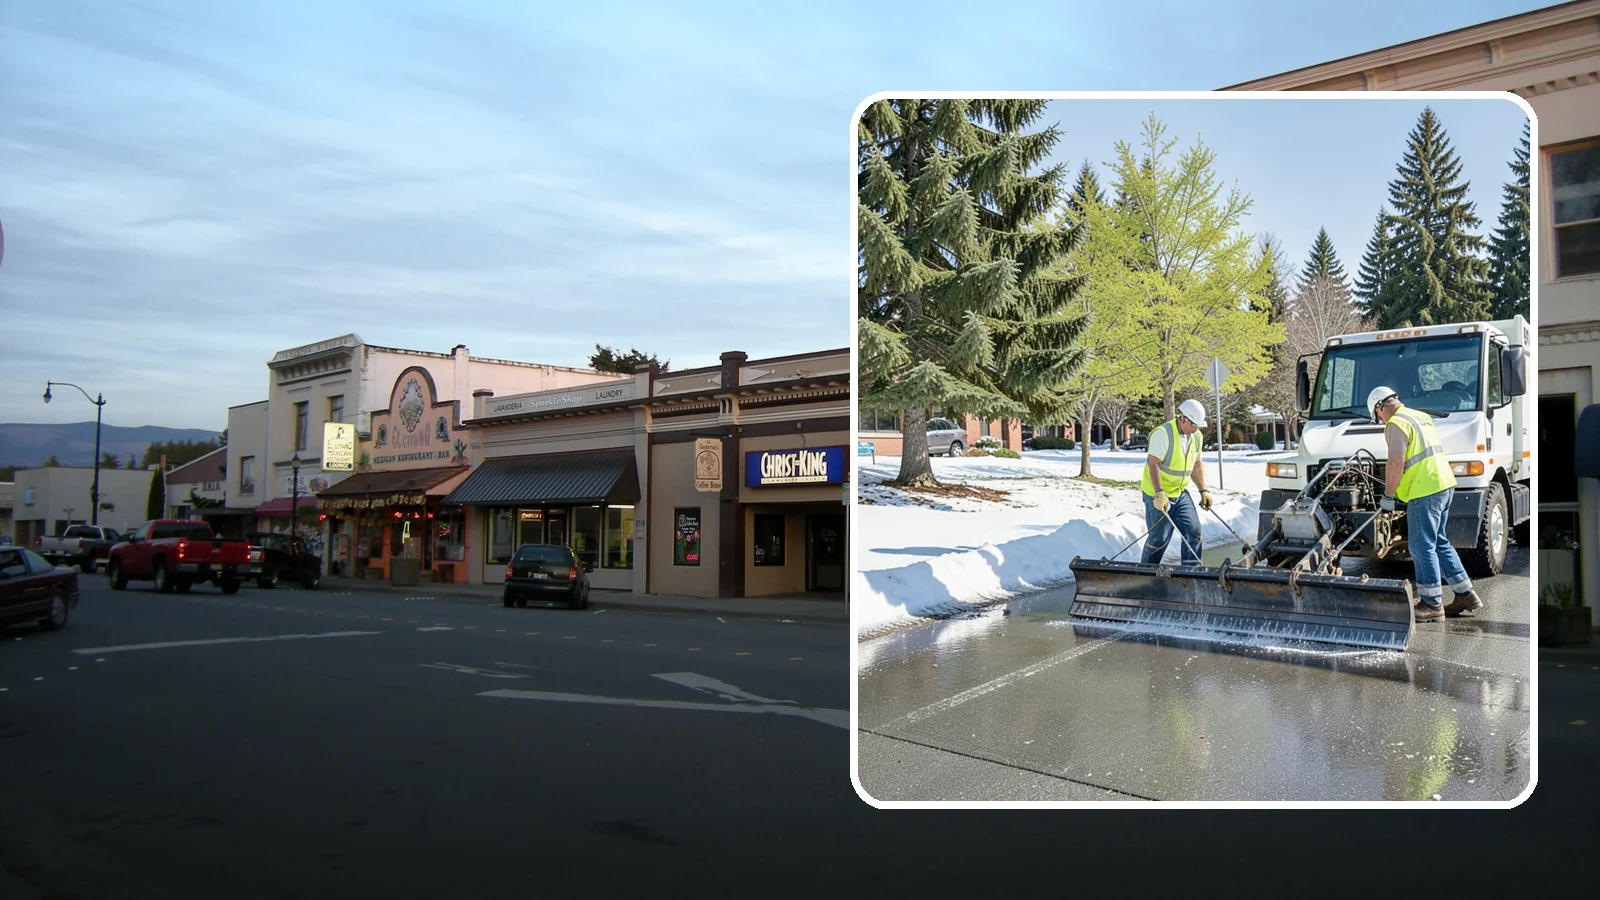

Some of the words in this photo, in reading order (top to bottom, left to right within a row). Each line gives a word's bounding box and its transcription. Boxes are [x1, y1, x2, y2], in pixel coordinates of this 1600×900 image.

[530, 397, 561, 409] Sparkle
[562, 394, 582, 405] Shop
[595, 389, 624, 400] LAUNDRY
[493, 402, 522, 413] LAVANDERIA
[392, 425, 402, 449] EL
[373, 455, 396, 464] MEXICAN
[397, 451, 433, 462] RESTAURANT
[437, 450, 450, 459] BAR
